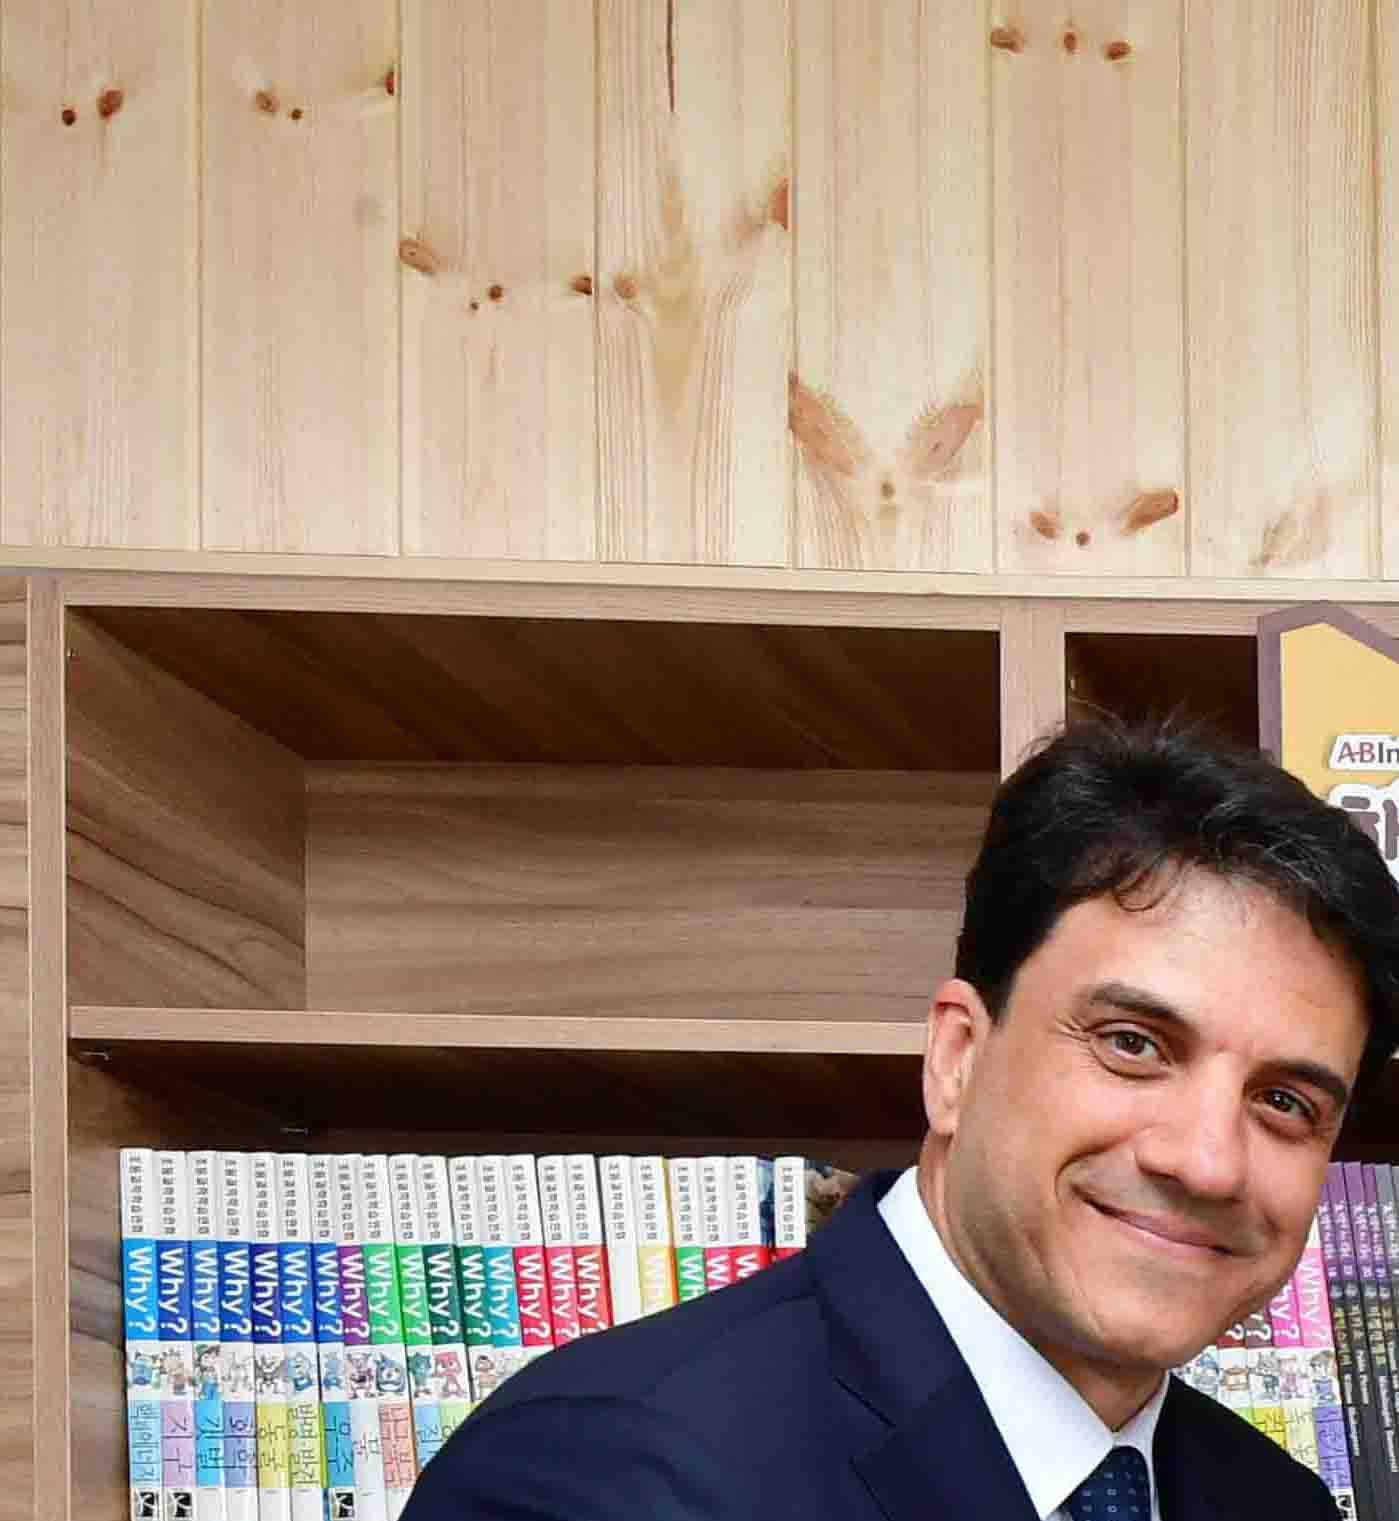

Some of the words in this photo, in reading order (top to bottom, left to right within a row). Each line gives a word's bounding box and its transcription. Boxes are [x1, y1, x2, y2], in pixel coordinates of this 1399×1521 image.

[126, 1247, 157, 1332] Why?
[158, 1248, 188, 1333] Why?
[191, 1248, 220, 1333] Why?
[222, 1249, 252, 1334] Why?
[253, 1251, 282, 1337] Why?
[282, 1251, 312, 1336] Why?
[315, 1250, 344, 1335] Why?
[341, 1253, 370, 1338] Why?
[368, 1251, 400, 1336] Why?
[402, 1253, 431, 1336] Why?
[427, 1252, 459, 1336] Why?
[462, 1253, 492, 1337] Why?
[488, 1253, 518, 1336] Why?
[518, 1253, 550, 1338] Why?
[550, 1255, 580, 1337] Why?
[163, 1417, 194, 1473] 지구
[327, 1422, 354, 1474] 우주
